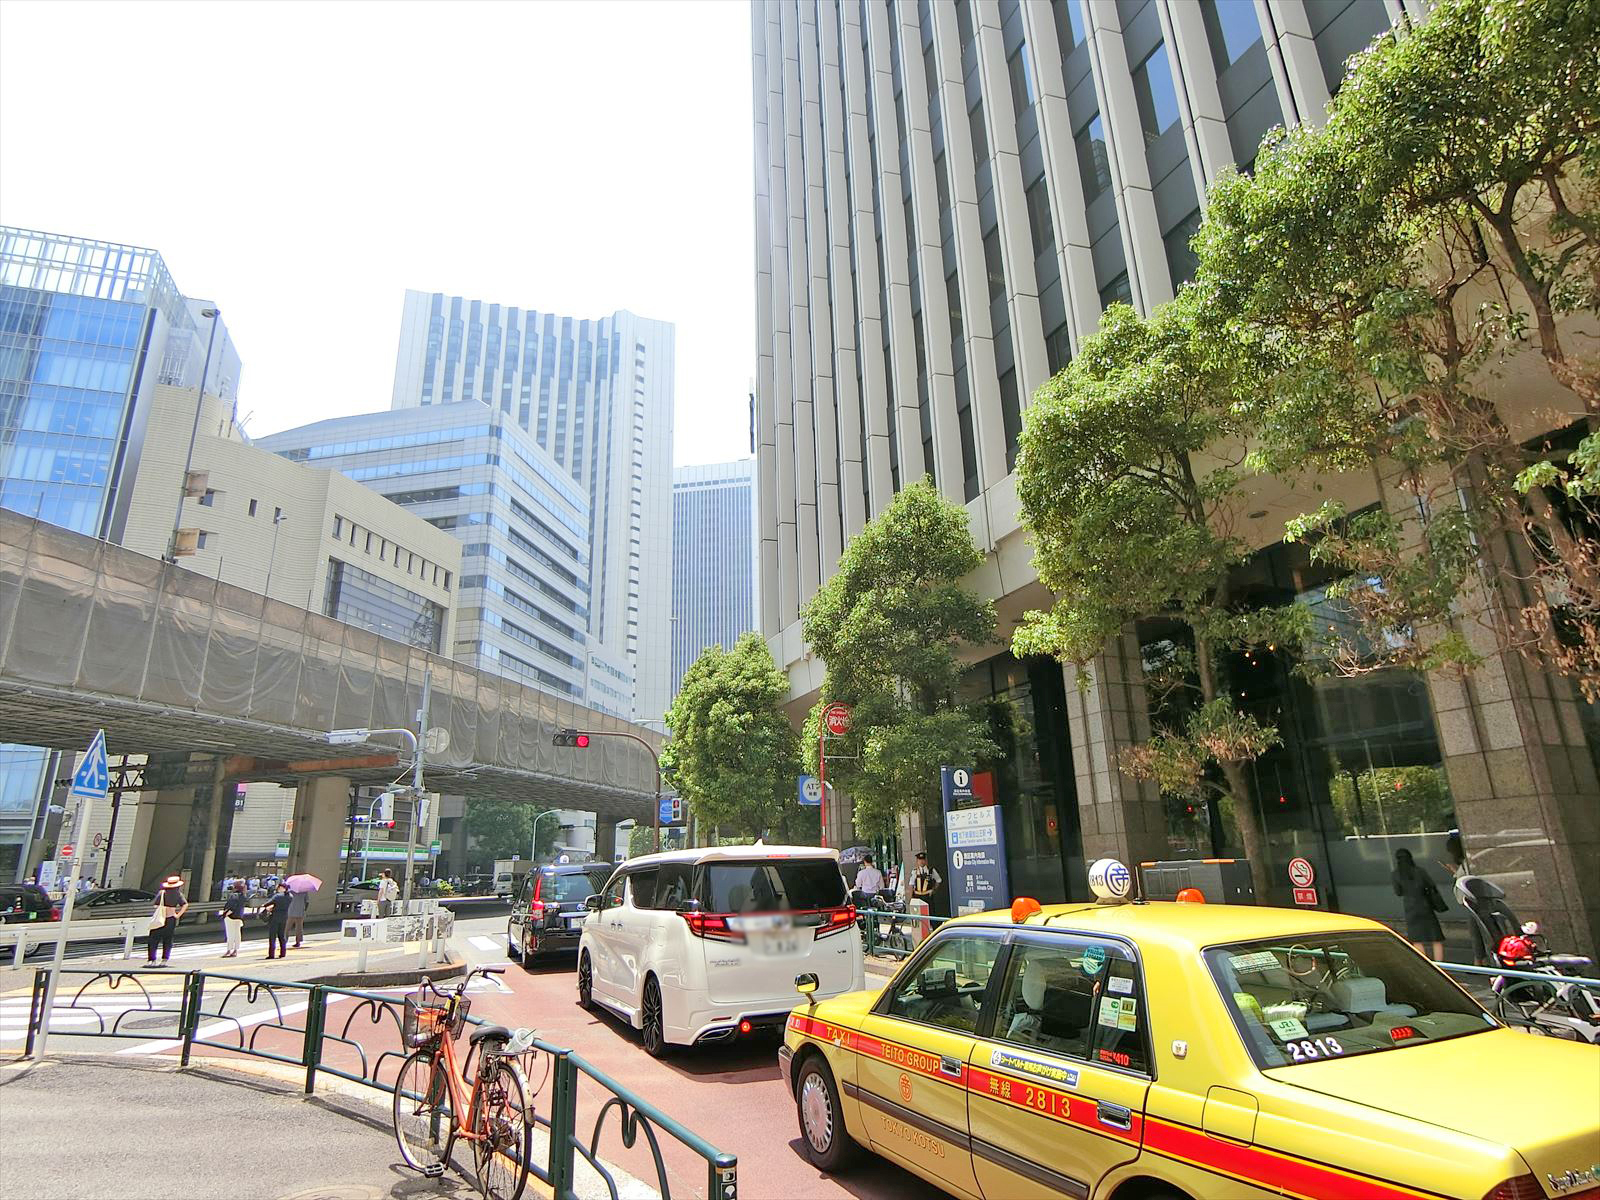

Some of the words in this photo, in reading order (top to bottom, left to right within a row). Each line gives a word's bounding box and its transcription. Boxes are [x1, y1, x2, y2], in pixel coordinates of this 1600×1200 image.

[826, 1026, 851, 1045] TAXI
[1286, 1036, 1344, 1062] 2813
[880, 1043, 905, 1062] TEITO
[906, 1053, 940, 1073] GROUP
[989, 1077, 1011, 1099] 無線
[1026, 1087, 1071, 1118] 2813
[881, 1116, 911, 1142] TOKYO
[912, 1131, 945, 1159] KOTSU
